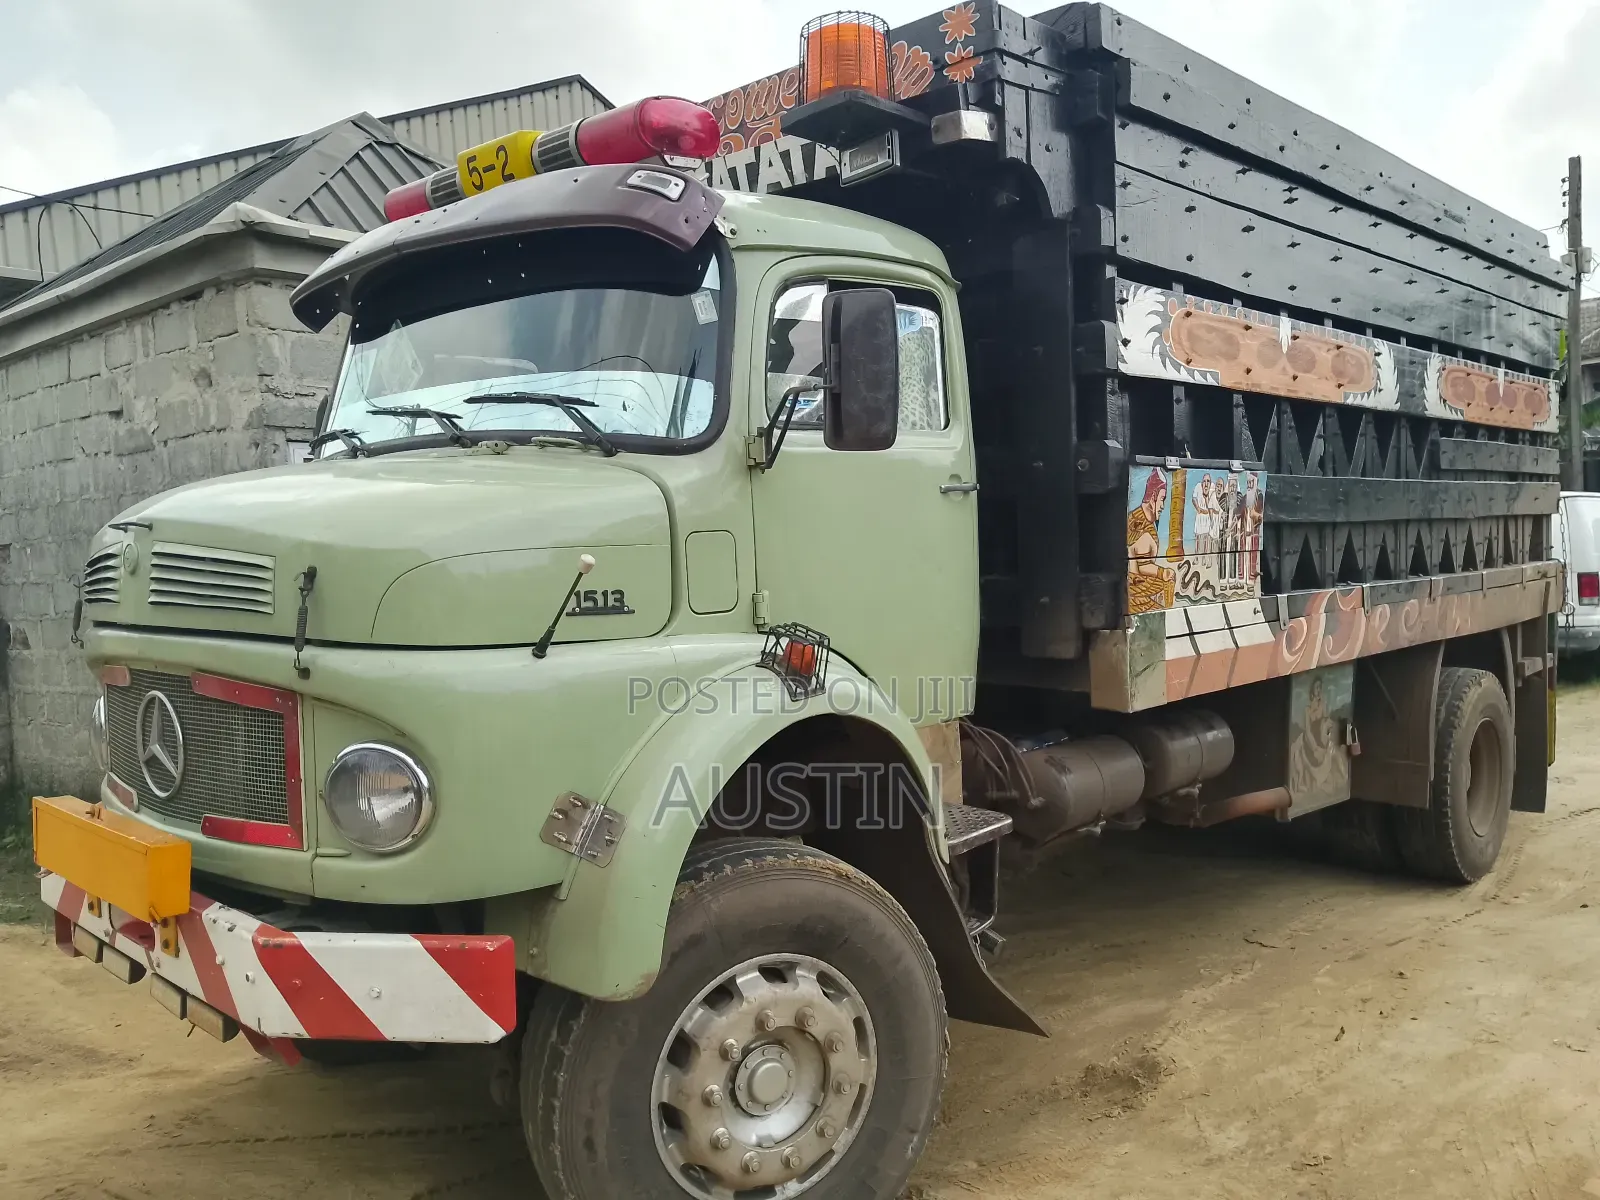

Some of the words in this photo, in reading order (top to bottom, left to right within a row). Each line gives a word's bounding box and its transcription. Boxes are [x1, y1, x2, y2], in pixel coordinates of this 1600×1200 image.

[466, 144, 515, 191] 5-2
[697, 134, 842, 194] ATATA
[573, 589, 626, 609] 1513
